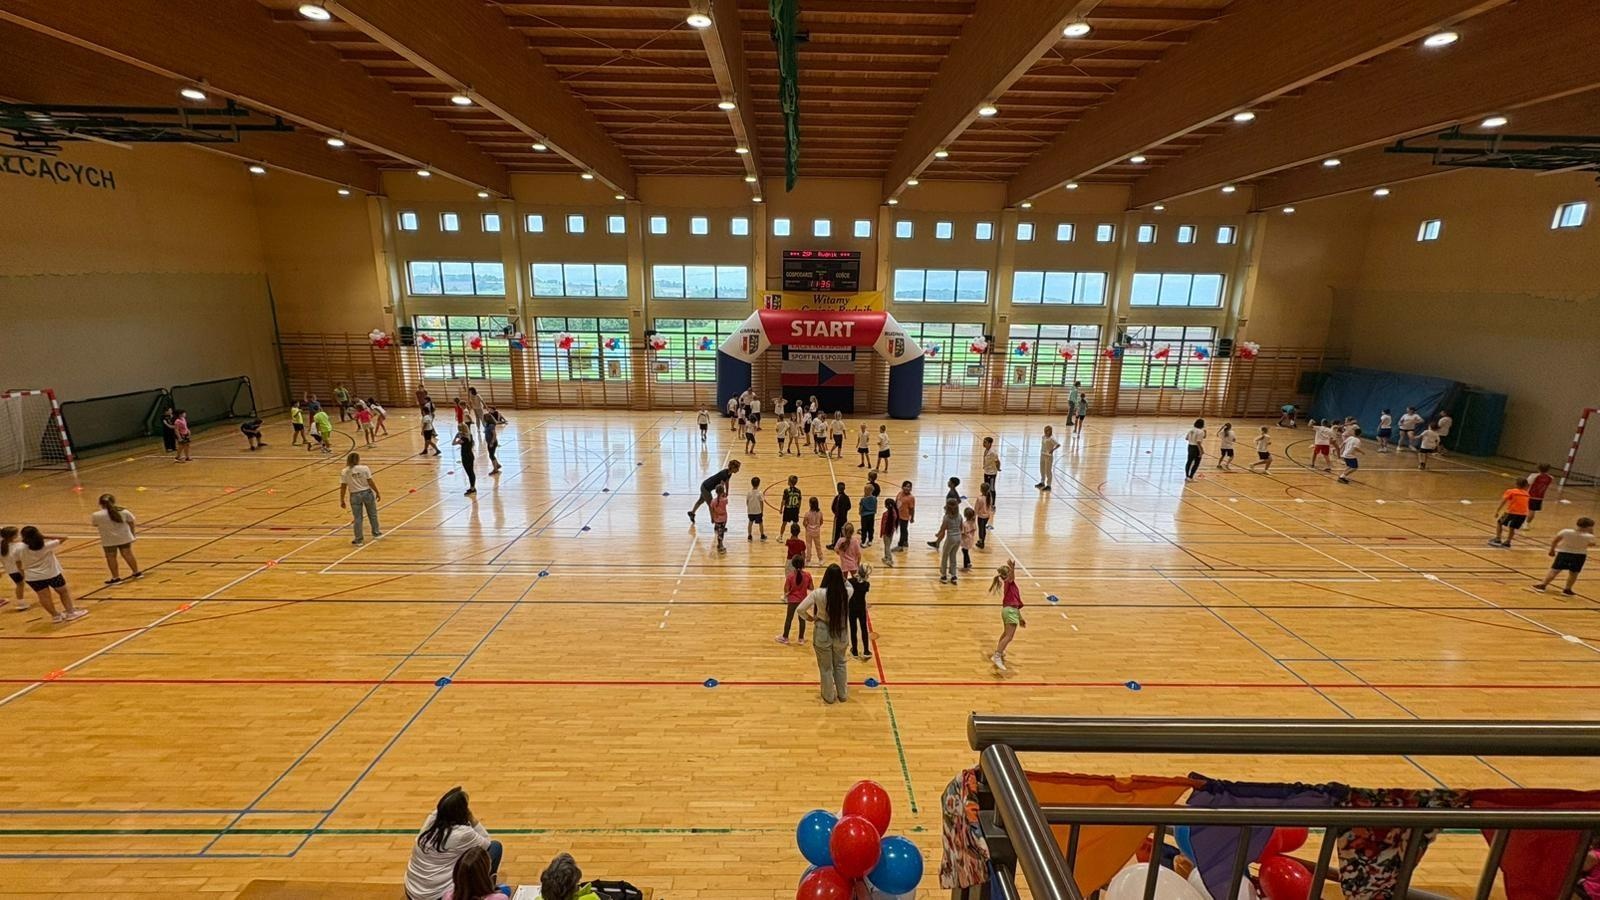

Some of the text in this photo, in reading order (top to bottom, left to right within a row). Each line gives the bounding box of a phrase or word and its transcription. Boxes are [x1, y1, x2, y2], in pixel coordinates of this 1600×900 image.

[813, 294, 850, 305] Witamy
[791, 320, 855, 338] START
[788, 495, 799, 506] 10
